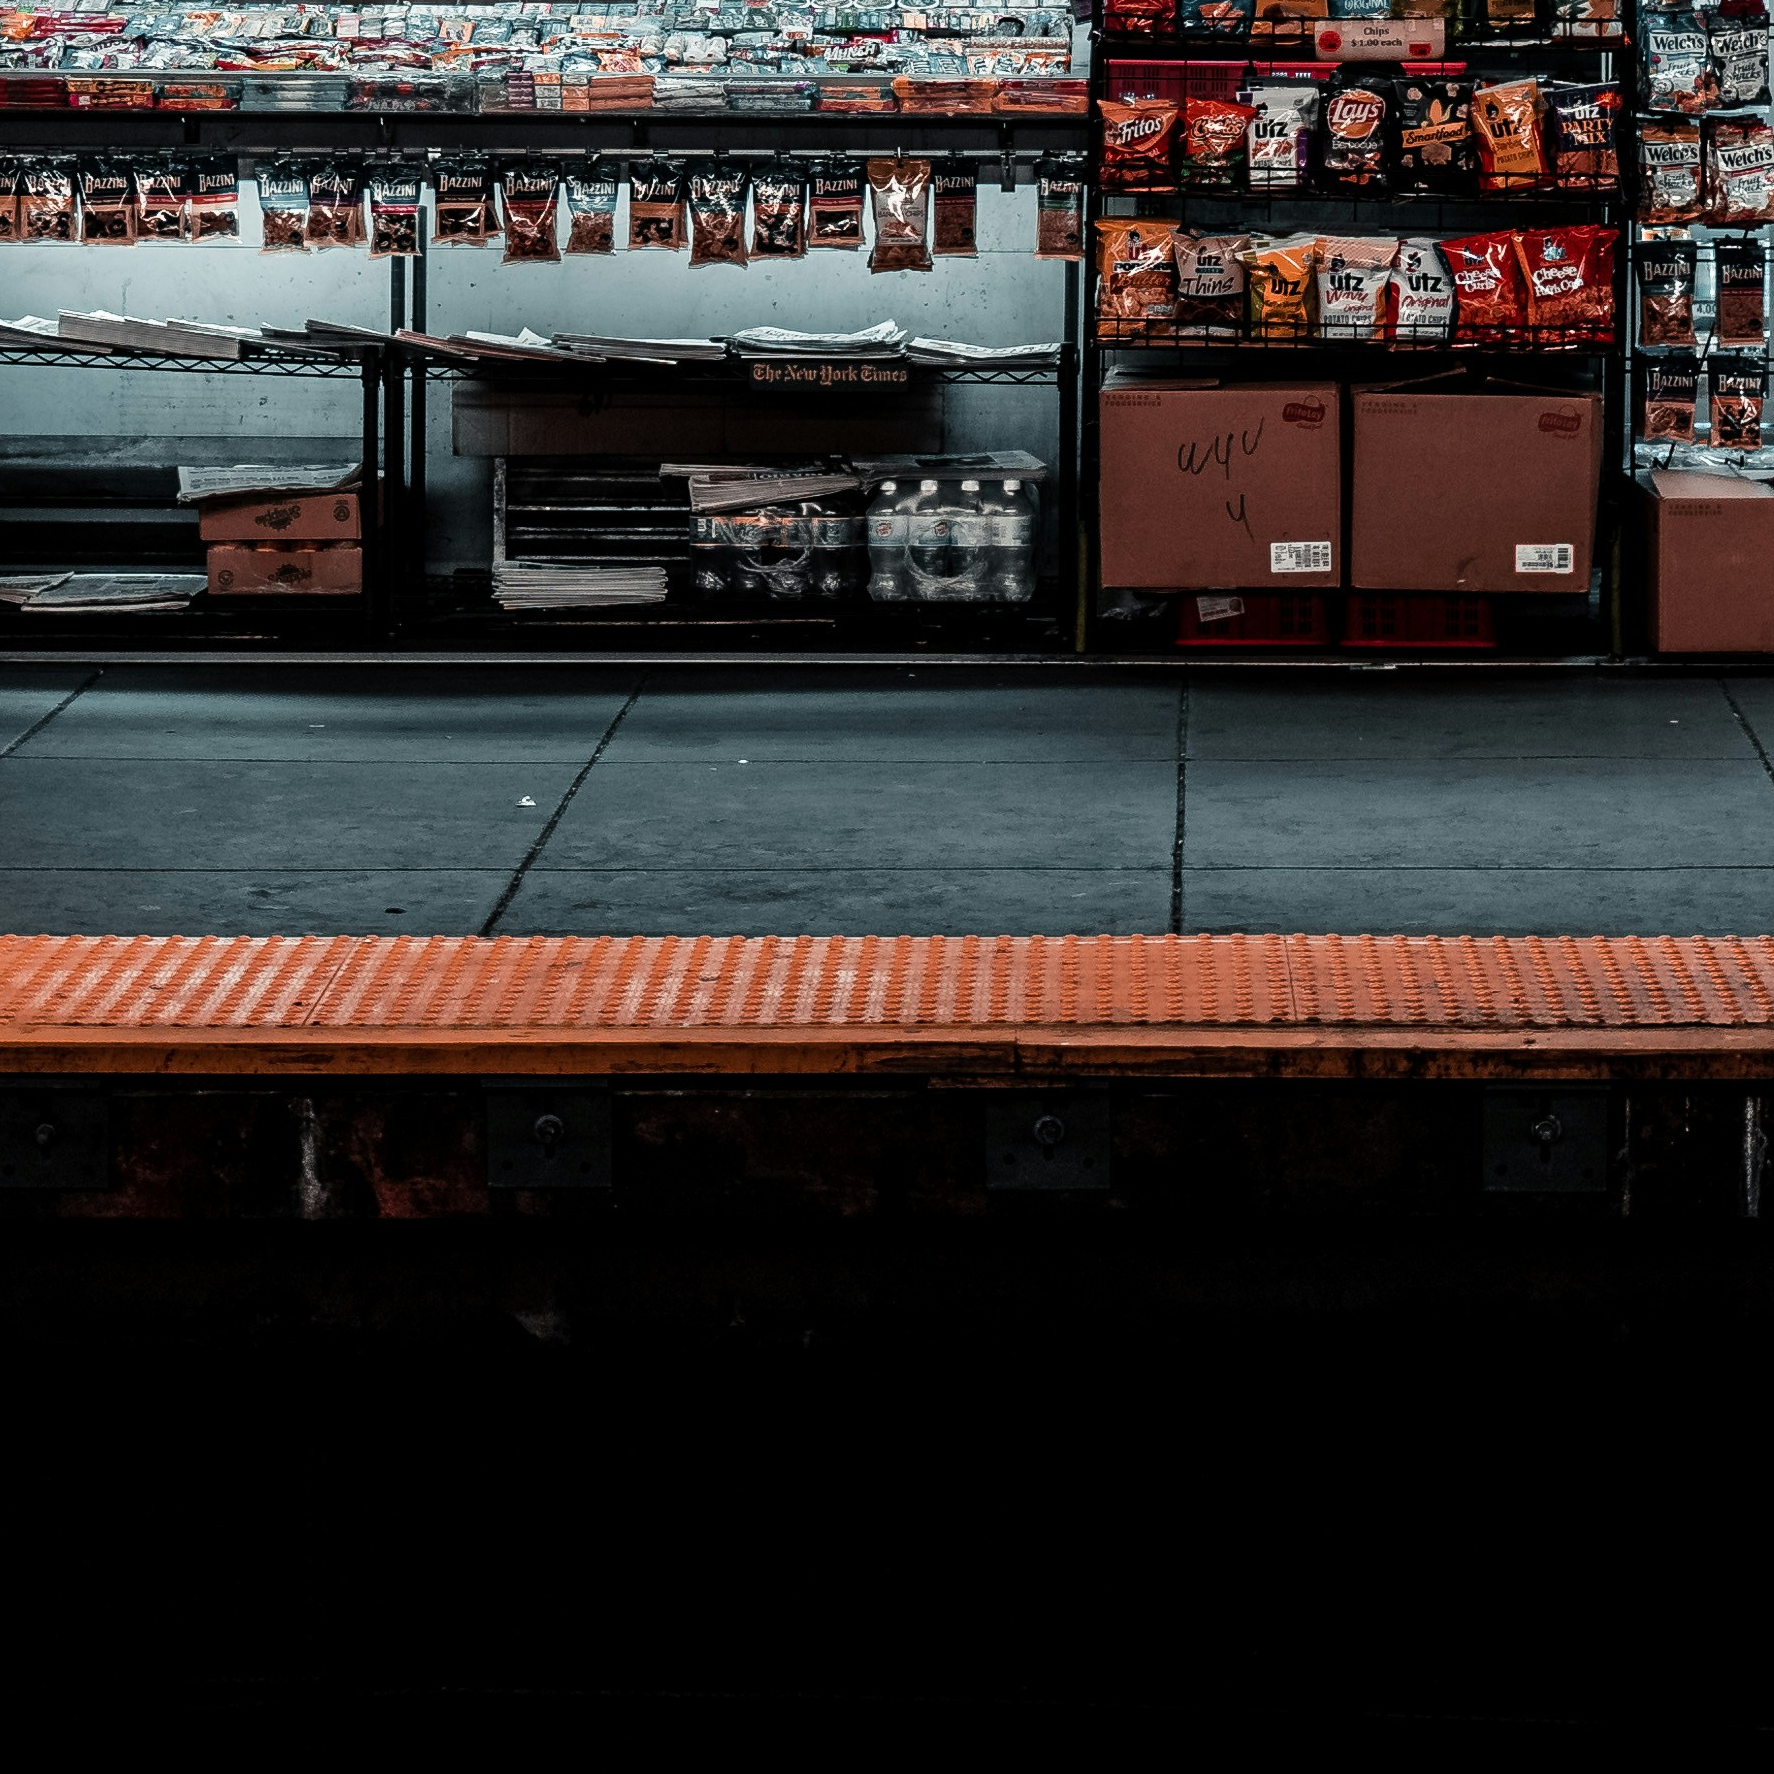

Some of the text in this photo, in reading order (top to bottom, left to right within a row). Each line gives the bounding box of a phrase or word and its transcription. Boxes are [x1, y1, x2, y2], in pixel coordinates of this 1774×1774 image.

[1363, 27, 1390, 37] Chips
[1380, 38, 1403, 48] each
[1654, 34, 1705, 51] Welch's
[1119, 116, 1162, 144] Fritos
[1406, 124, 1465, 145] Smartfood
[1722, 146, 1772, 167] Welch's
[199, 172, 235, 193] BAZZINI
[373, 181, 416, 200] BAZZINI
[439, 173, 483, 191] BAZZINI
[815, 177, 857, 196] BAZZINI
[935, 175, 975, 191] BAZZINI
[1644, 261, 1690, 281] BAZZINI
[1181, 275, 1234, 295] Thins
[753, 362, 908, 386] The New York Times
[1653, 372, 1693, 390] BAZZINI
